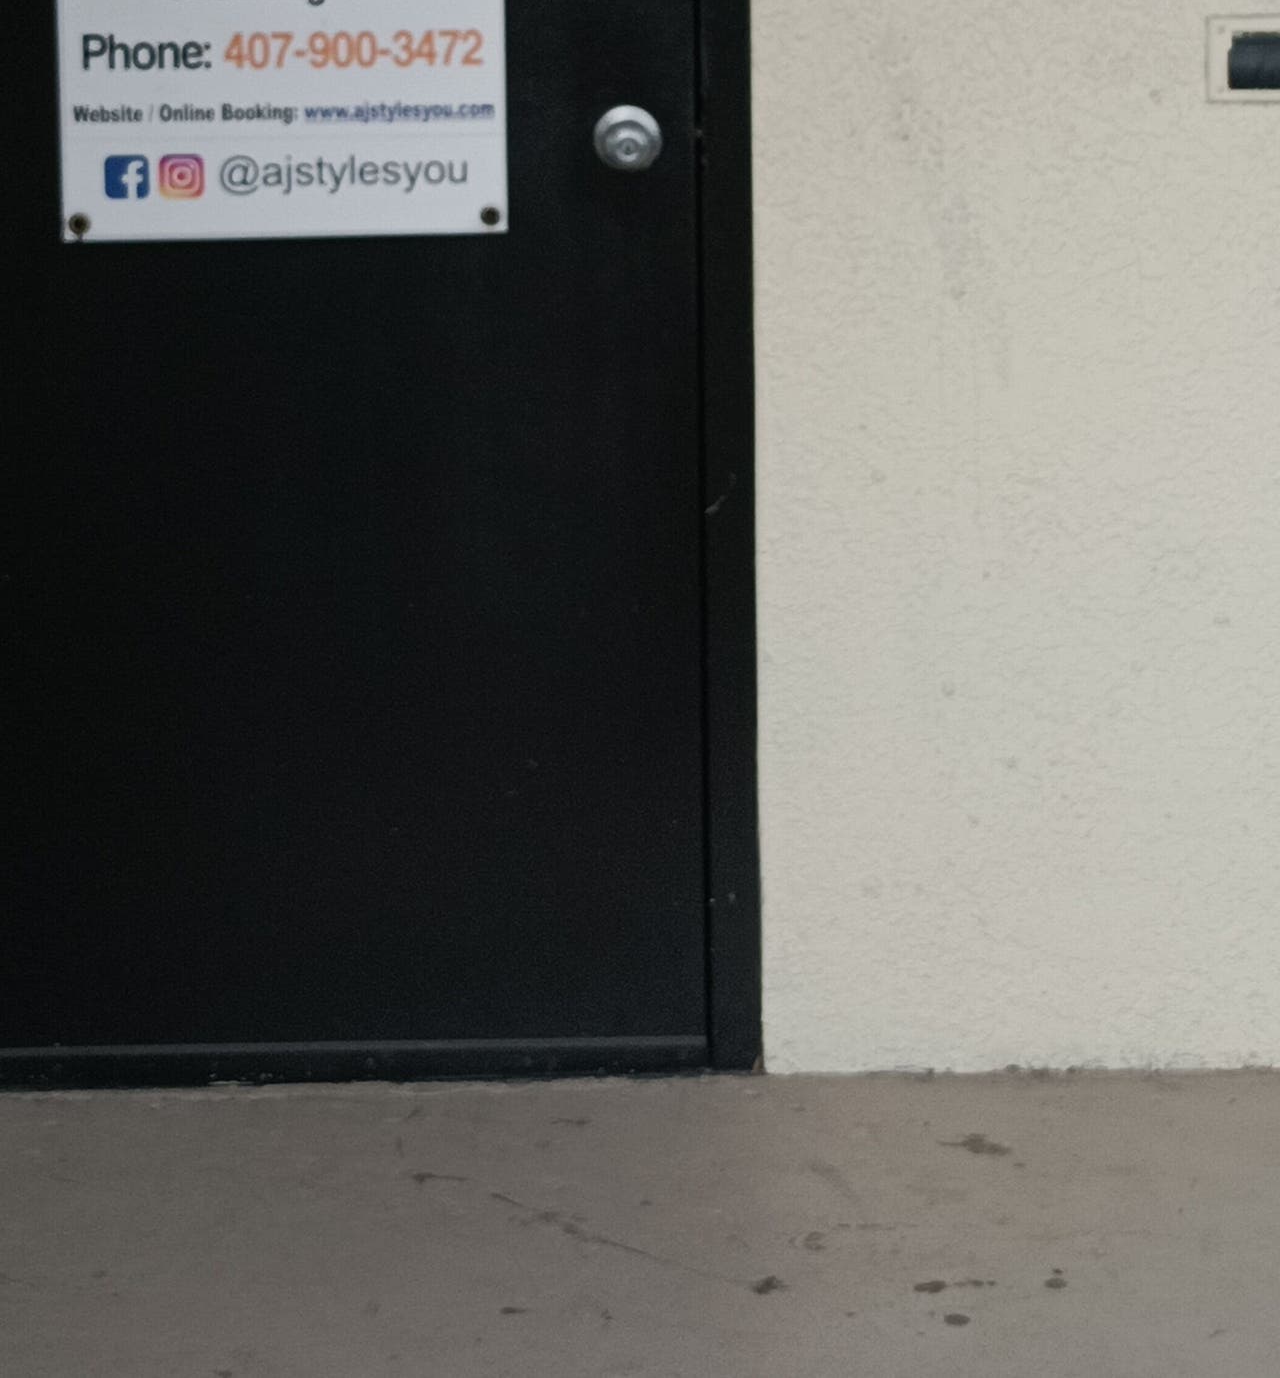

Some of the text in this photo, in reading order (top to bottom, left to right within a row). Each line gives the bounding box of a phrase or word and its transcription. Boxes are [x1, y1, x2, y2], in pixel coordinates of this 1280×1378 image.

[81, 30, 483, 70] Phone: 407-900-3472
[73, 105, 143, 123] Website
[159, 103, 215, 122] Online
[221, 102, 299, 124] Booking:
[304, 101, 496, 123] www.ajstylesyou.com
[220, 154, 468, 196] @ajstylesyou
